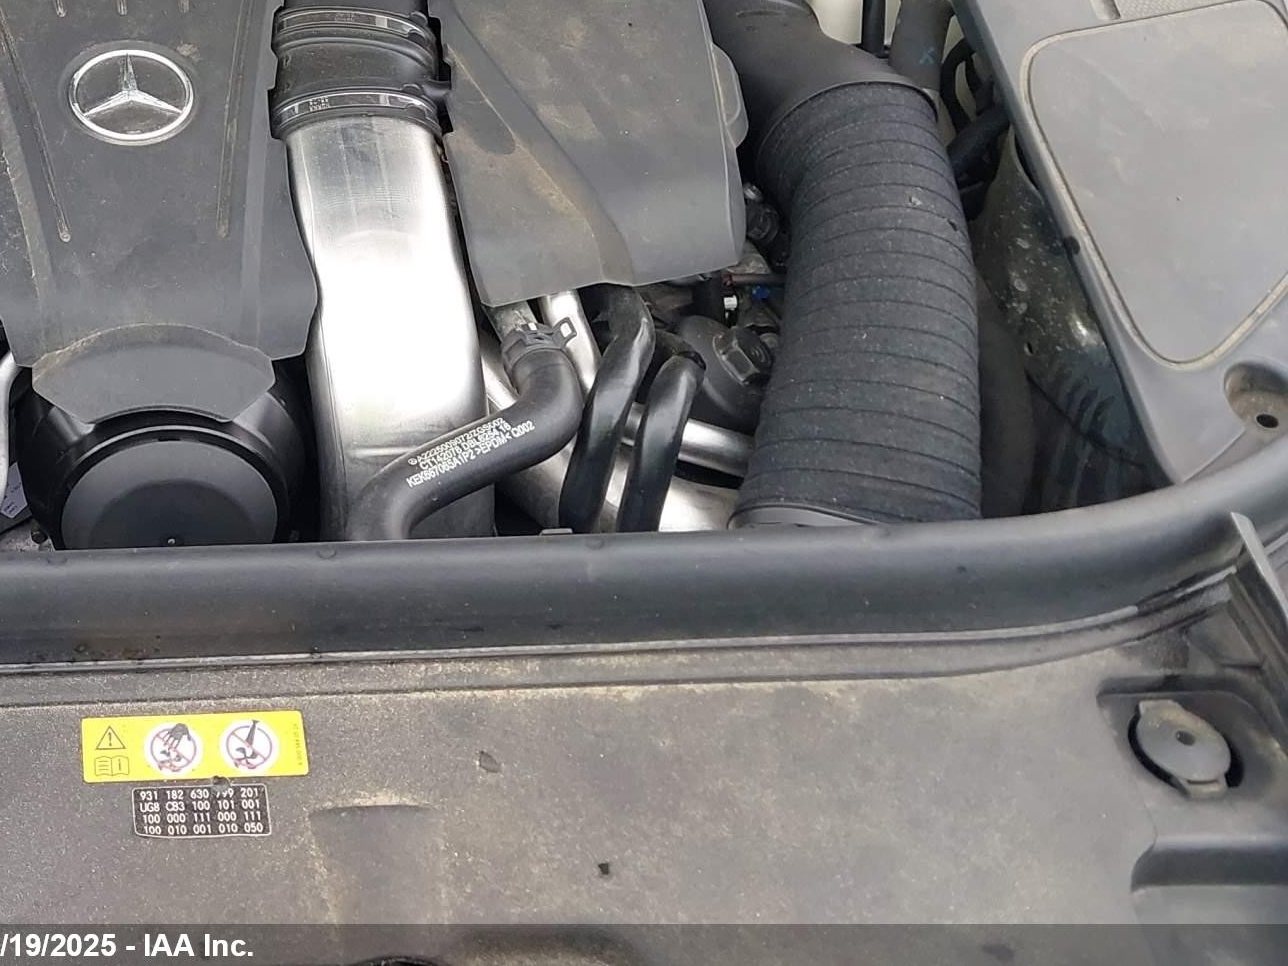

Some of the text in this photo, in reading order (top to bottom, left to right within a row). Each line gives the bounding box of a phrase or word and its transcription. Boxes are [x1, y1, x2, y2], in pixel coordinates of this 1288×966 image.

[140, 791, 158, 801] 931
[166, 790, 184, 800] 182
[190, 789, 209, 799] 630
[240, 787, 259, 797] 201
[139, 802, 160, 812] UG8
[192, 801, 211, 811] 100
[218, 800, 235, 810] 101
[241, 799, 260, 809] 001
[143, 811, 261, 824] 100 000 111 000 111
[144, 822, 263, 835] 100 010 001 010 050
